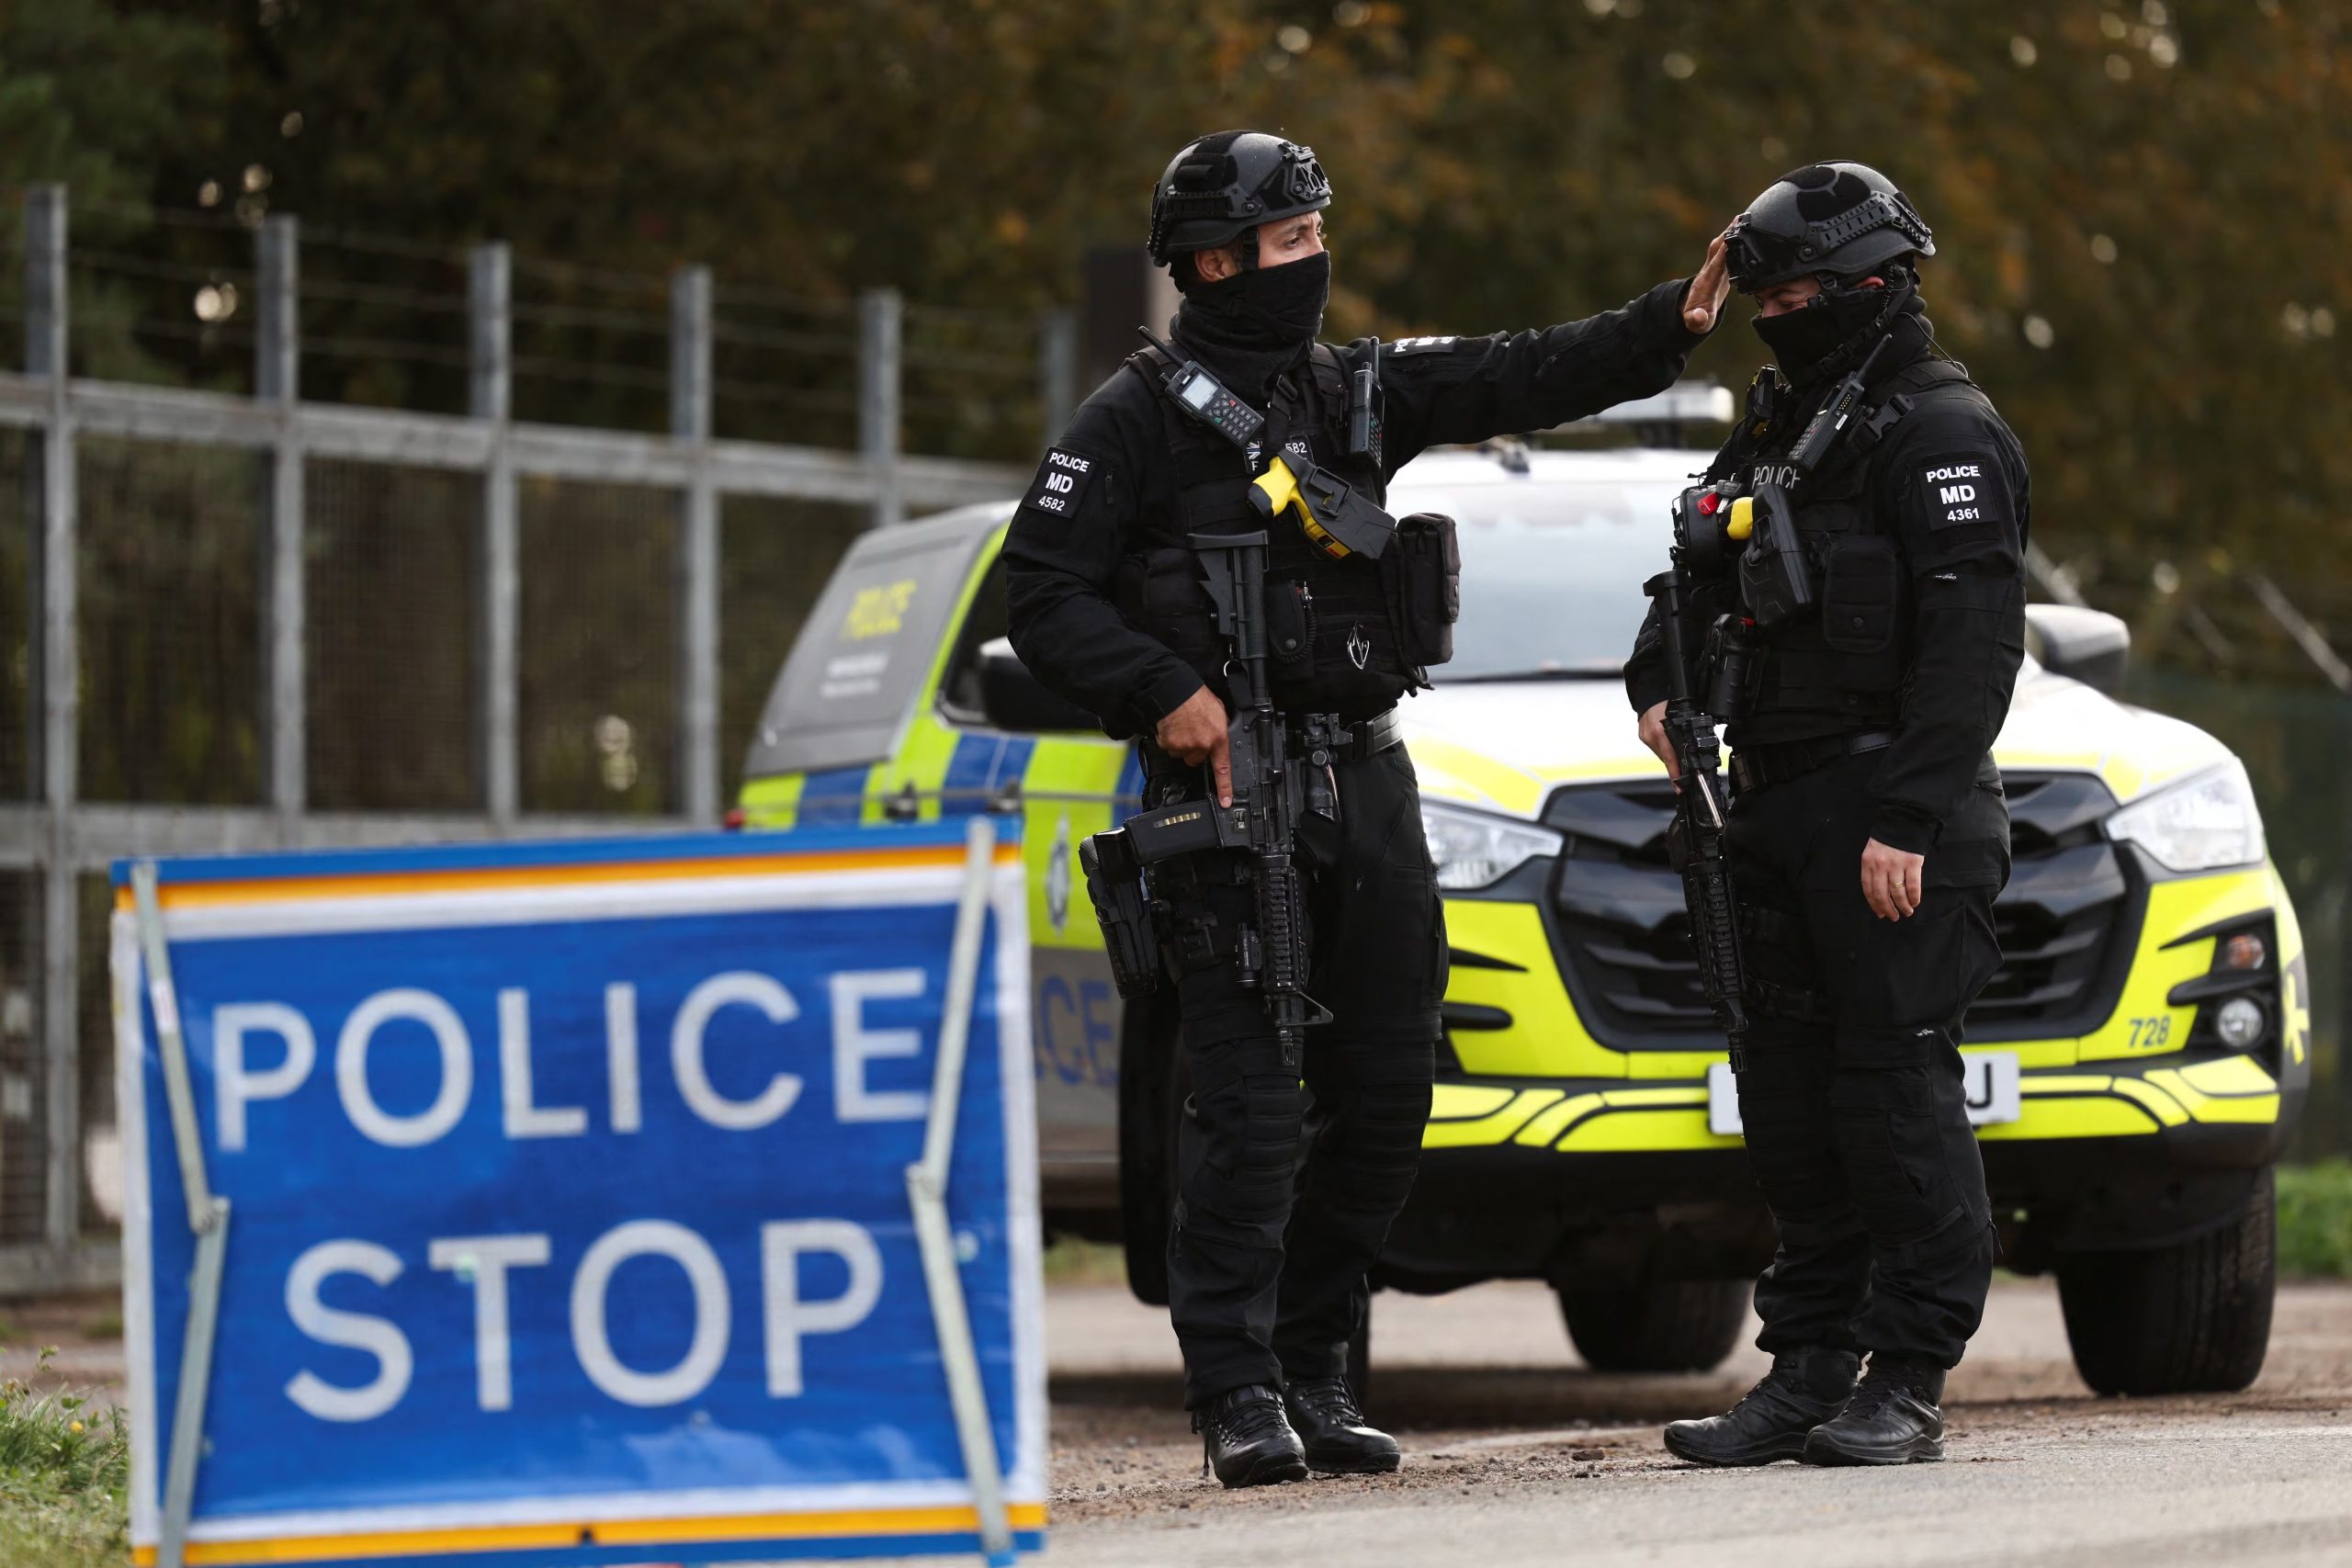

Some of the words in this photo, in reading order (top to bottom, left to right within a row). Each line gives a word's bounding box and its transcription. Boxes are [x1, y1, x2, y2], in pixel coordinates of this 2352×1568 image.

[1285, 442, 1307, 454] 582
[1049, 452, 1091, 473] POLICE
[1045, 471, 1074, 494] MD
[1926, 465, 1981, 483] POLICE
[1037, 495, 1066, 512] 4582
[1939, 484, 1976, 505] MD
[1947, 507, 1980, 522] 4361
[2129, 1015, 2171, 1048] 728
[212, 968, 928, 1152] POLICE
[284, 1217, 884, 1423] STOP
